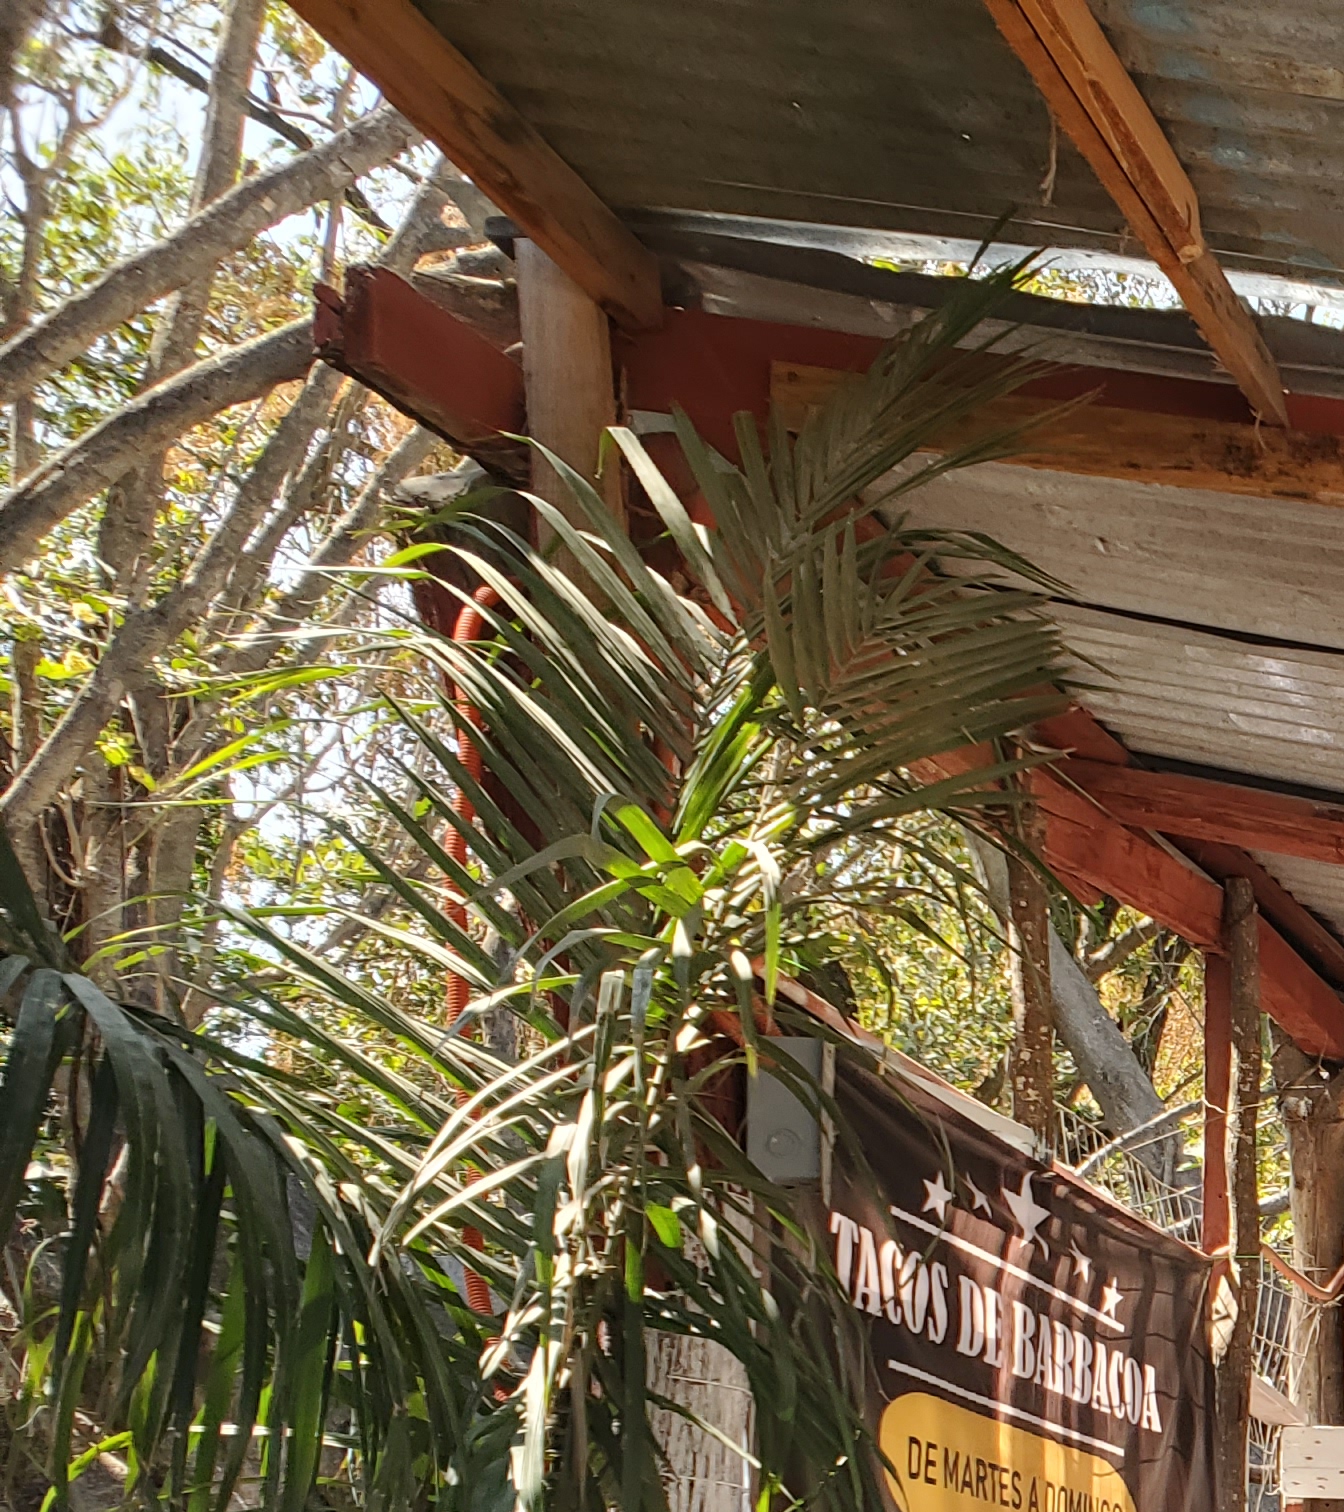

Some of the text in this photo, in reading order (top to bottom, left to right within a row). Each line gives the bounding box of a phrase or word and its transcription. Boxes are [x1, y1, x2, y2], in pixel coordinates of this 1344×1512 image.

[830, 1211, 1163, 1433] TACOS DE BARBACOA
[908, 1436, 938, 1486] DE
[943, 1447, 1023, 1511] MARTES
